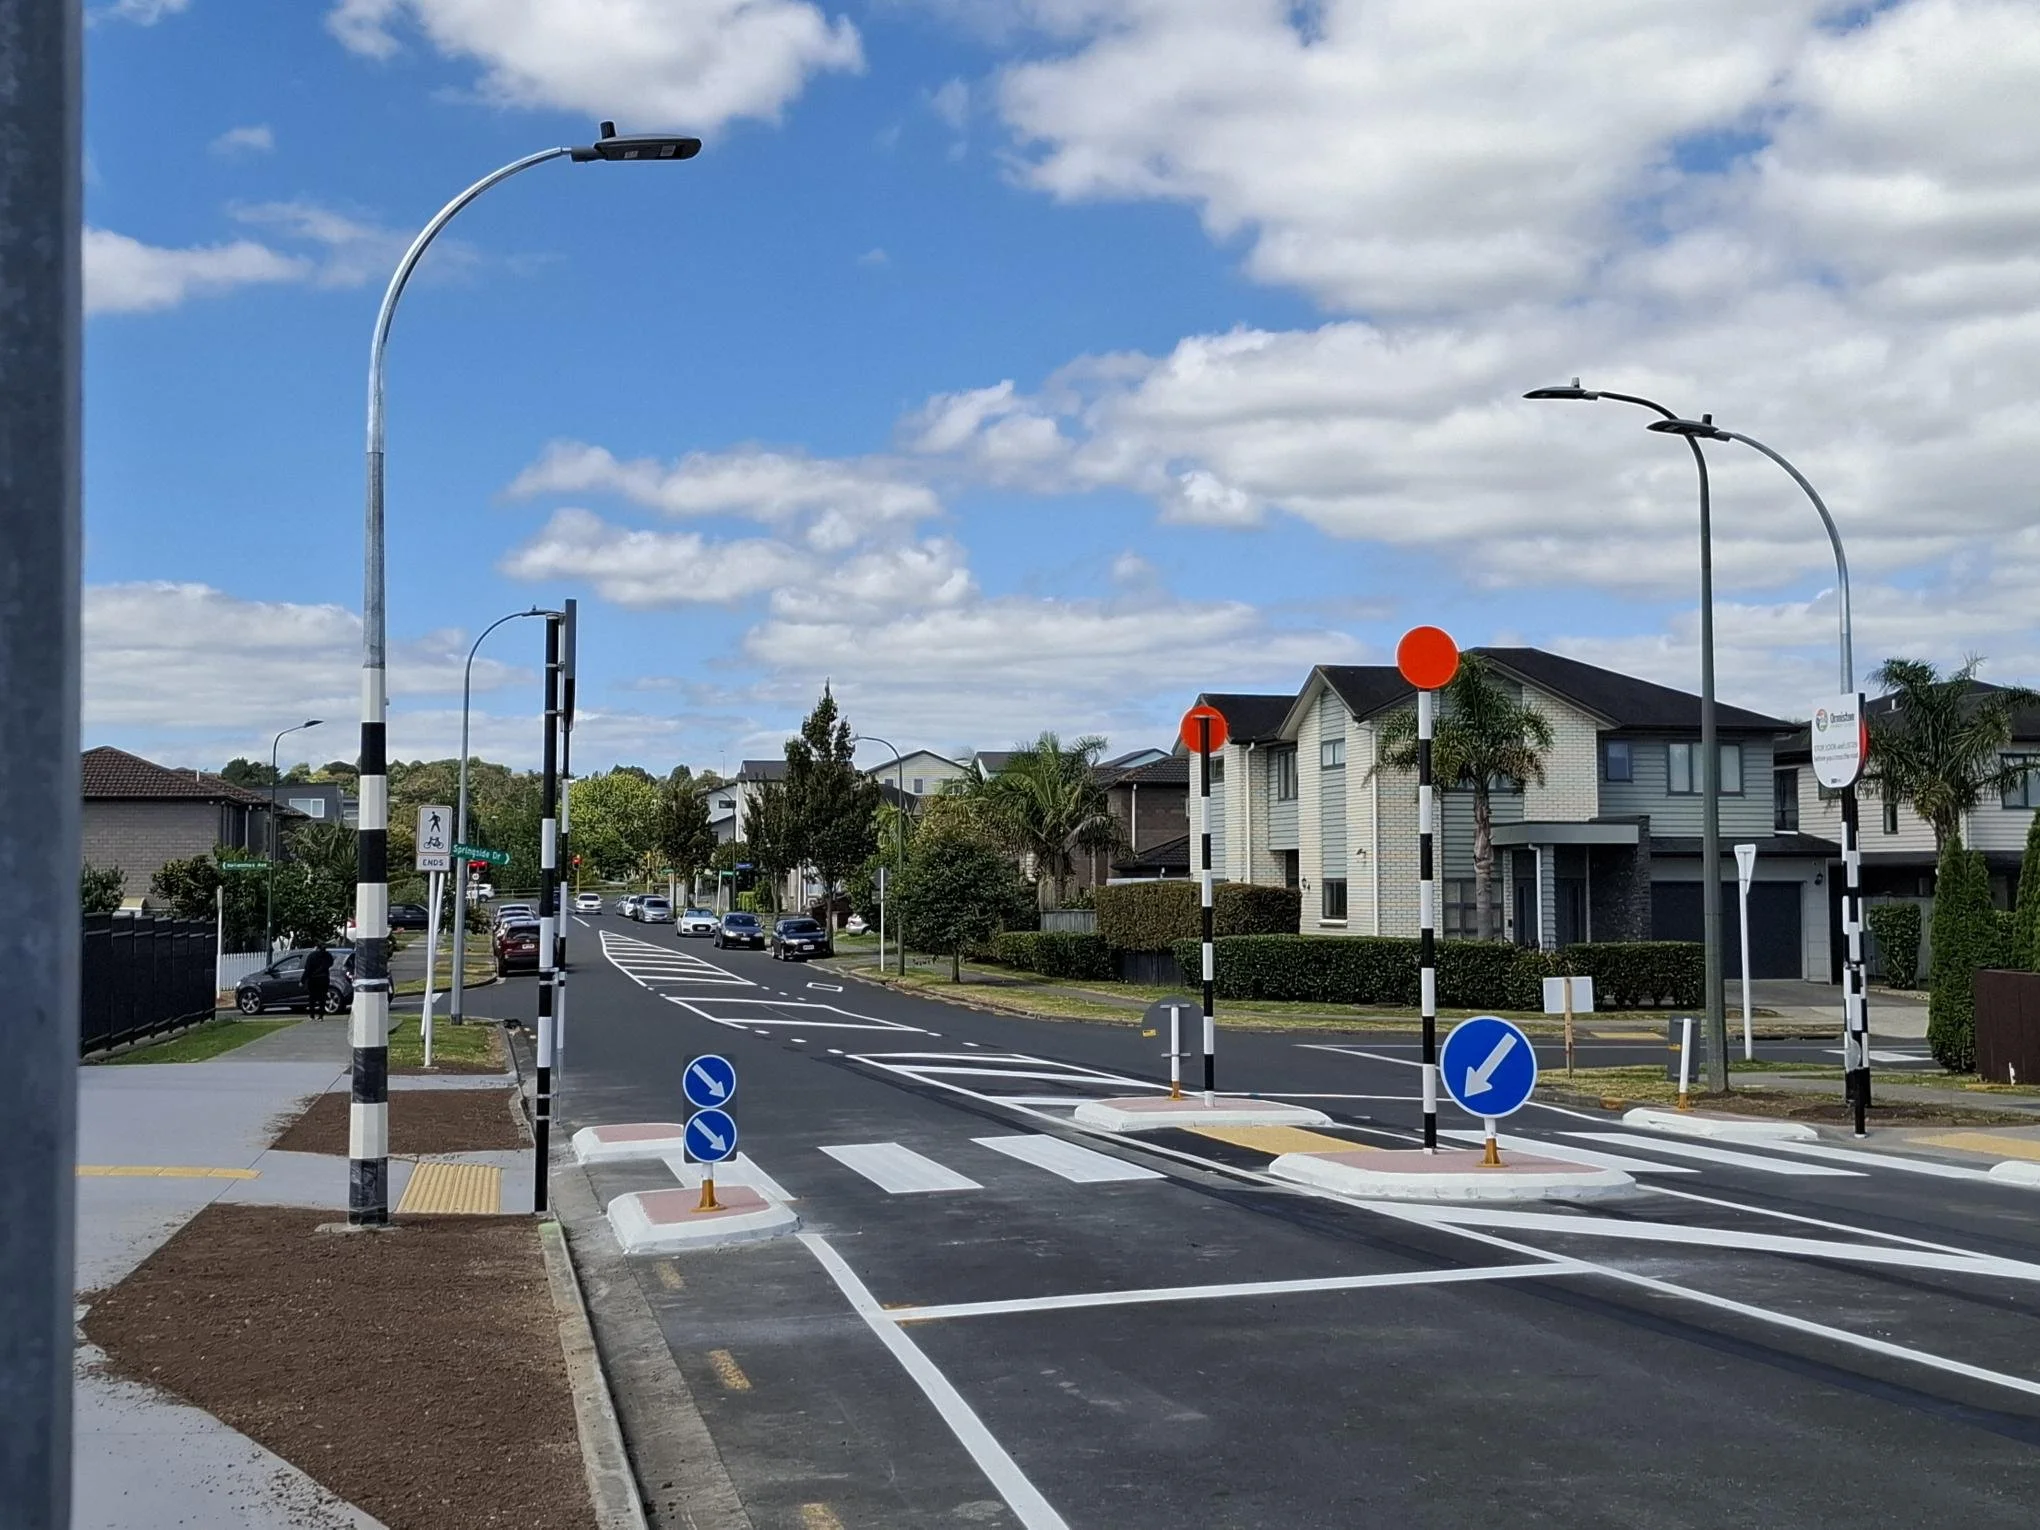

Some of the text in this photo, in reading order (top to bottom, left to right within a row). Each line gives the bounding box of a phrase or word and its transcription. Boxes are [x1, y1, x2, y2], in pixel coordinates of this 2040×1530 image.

[453, 844, 502, 860] Springside Dr
[422, 858, 444, 867] ENDS
